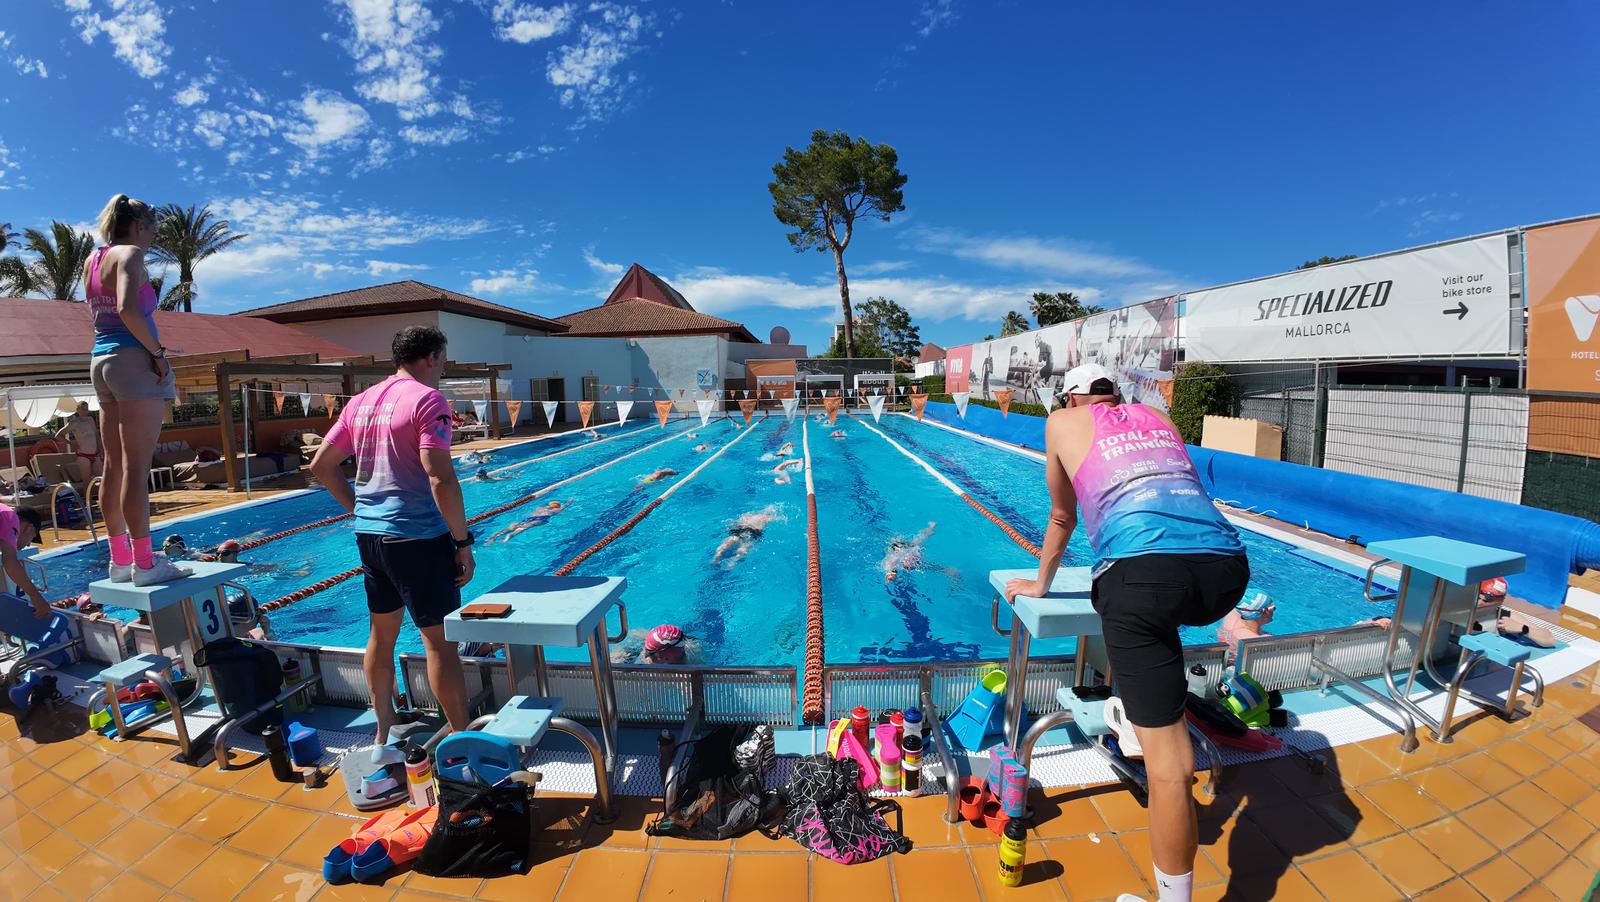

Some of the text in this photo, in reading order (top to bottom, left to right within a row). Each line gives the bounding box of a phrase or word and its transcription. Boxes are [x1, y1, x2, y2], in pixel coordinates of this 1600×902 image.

[1441, 274, 1483, 286] Visit our
[1253, 280, 1393, 321] SPECIALIZED
[1442, 286, 1492, 298] bike store
[1285, 322, 1351, 339] MALLORCA
[1096, 429, 1176, 450] TOTAL TRI
[1101, 439, 1182, 461] TRAINING
[202, 599, 220, 635] 3
